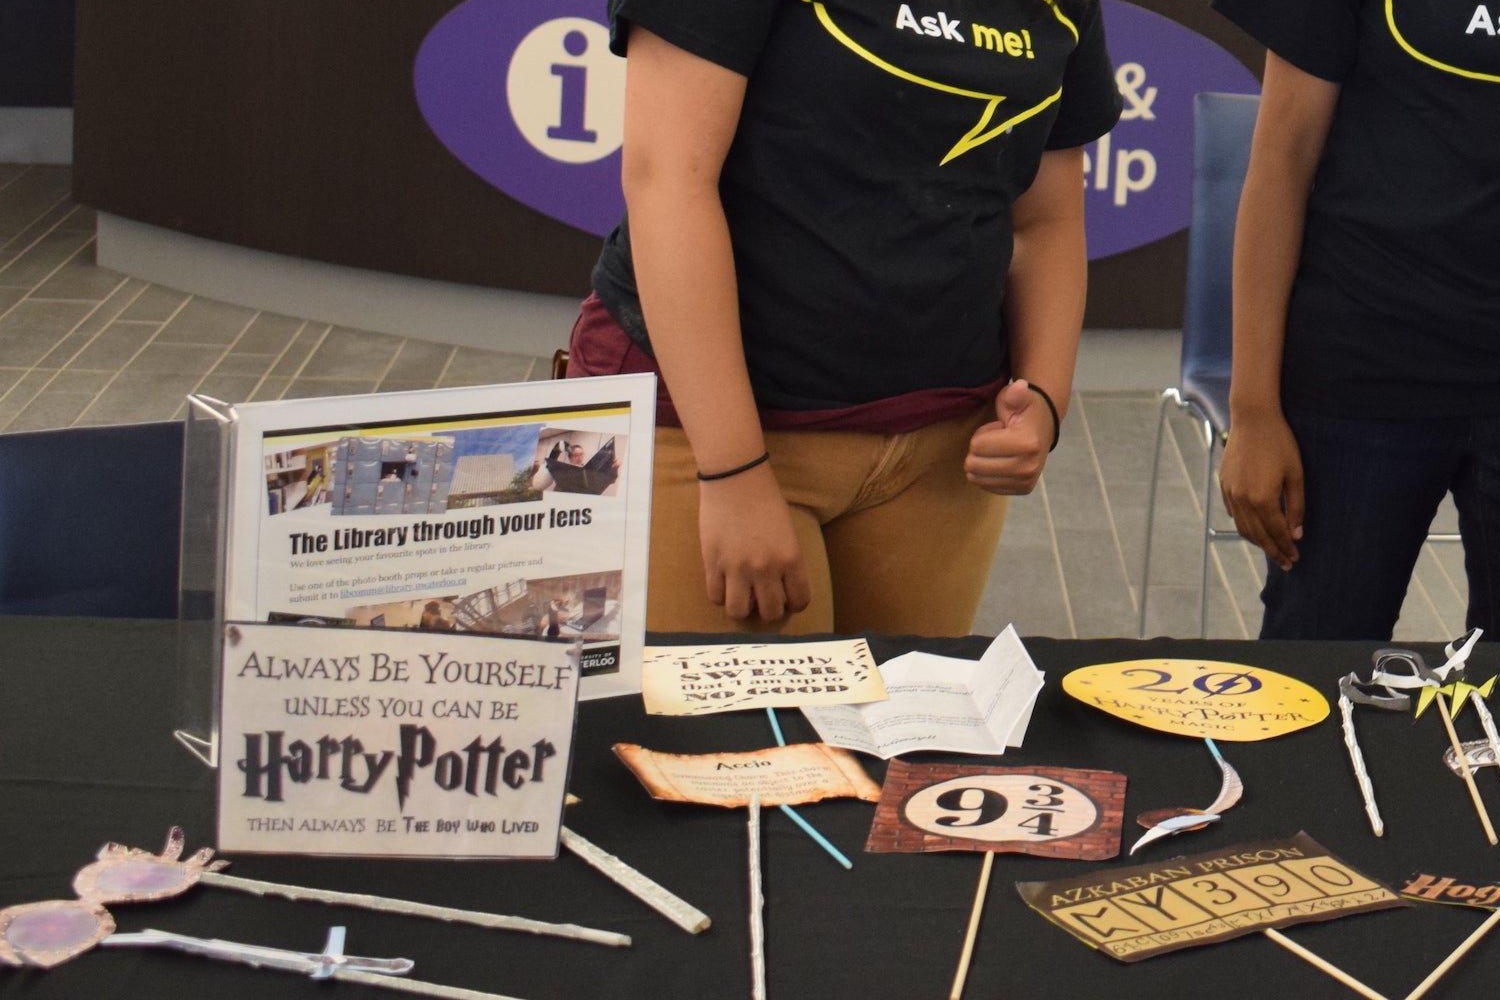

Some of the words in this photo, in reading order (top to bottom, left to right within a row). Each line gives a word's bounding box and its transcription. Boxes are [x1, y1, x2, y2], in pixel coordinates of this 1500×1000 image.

[895, 3, 965, 43] Ask
[971, 20, 1036, 59] me!
[1114, 62, 1158, 122] &
[289, 532, 328, 555] The
[334, 525, 408, 551] Library
[413, 515, 495, 543] through
[500, 511, 546, 536] your
[549, 508, 592, 529] lens
[290, 560, 304, 568] We
[306, 558, 325, 567] love
[354, 555, 374, 565] your
[375, 551, 414, 560] favourite
[416, 549, 437, 558] spots
[439, 544, 447, 553] in
[449, 542, 463, 552] the
[289, 583, 306, 592] Use
[307, 582, 324, 590] one
[336, 579, 349, 587] the
[352, 575, 377, 587] photo
[378, 573, 403, 582] booth
[404, 571, 429, 582] props
[441, 566, 457, 576] take
[467, 562, 495, 575] regular
[497, 559, 526, 571] picture
[527, 557, 544, 566] and
[237, 651, 360, 682] ALWAYS
[369, 653, 409, 683] BE
[419, 652, 572, 690] YOURSELF
[680, 666, 842, 682] SWEAR
[699, 655, 833, 669] solemnly
[680, 682, 723, 692] that
[750, 677, 781, 685] am
[789, 677, 816, 688] up
[823, 675, 844, 683] to
[684, 690, 736, 702] NO
[746, 684, 849, 696] GOOD
[285, 696, 371, 718] UNLESS
[378, 698, 425, 718] YOU
[432, 700, 483, 720] CAN
[490, 701, 519, 721] BE
[1091, 695, 1197, 718] HARRY
[1192, 707, 1316, 723] POTTER
[1148, 696, 1216, 706] YEARS
[1218, 701, 1249, 709] OF
[1168, 718, 1238, 732] MAGIC
[237, 730, 395, 802] Harry
[396, 723, 556, 814] Potter
[715, 760, 773, 771] Accio
[935, 787, 1009, 828] 9
[247, 817, 294, 832] THEN
[300, 817, 367, 833] ALWAYS
[376, 819, 396, 833] BE
[402, 816, 430, 834] THE
[435, 818, 461, 834] BOY
[466, 819, 495, 833] WHO
[501, 819, 539, 834] LIVED
[1050, 865, 1191, 907] AZKABAN
[1194, 846, 1305, 874] PRISON
